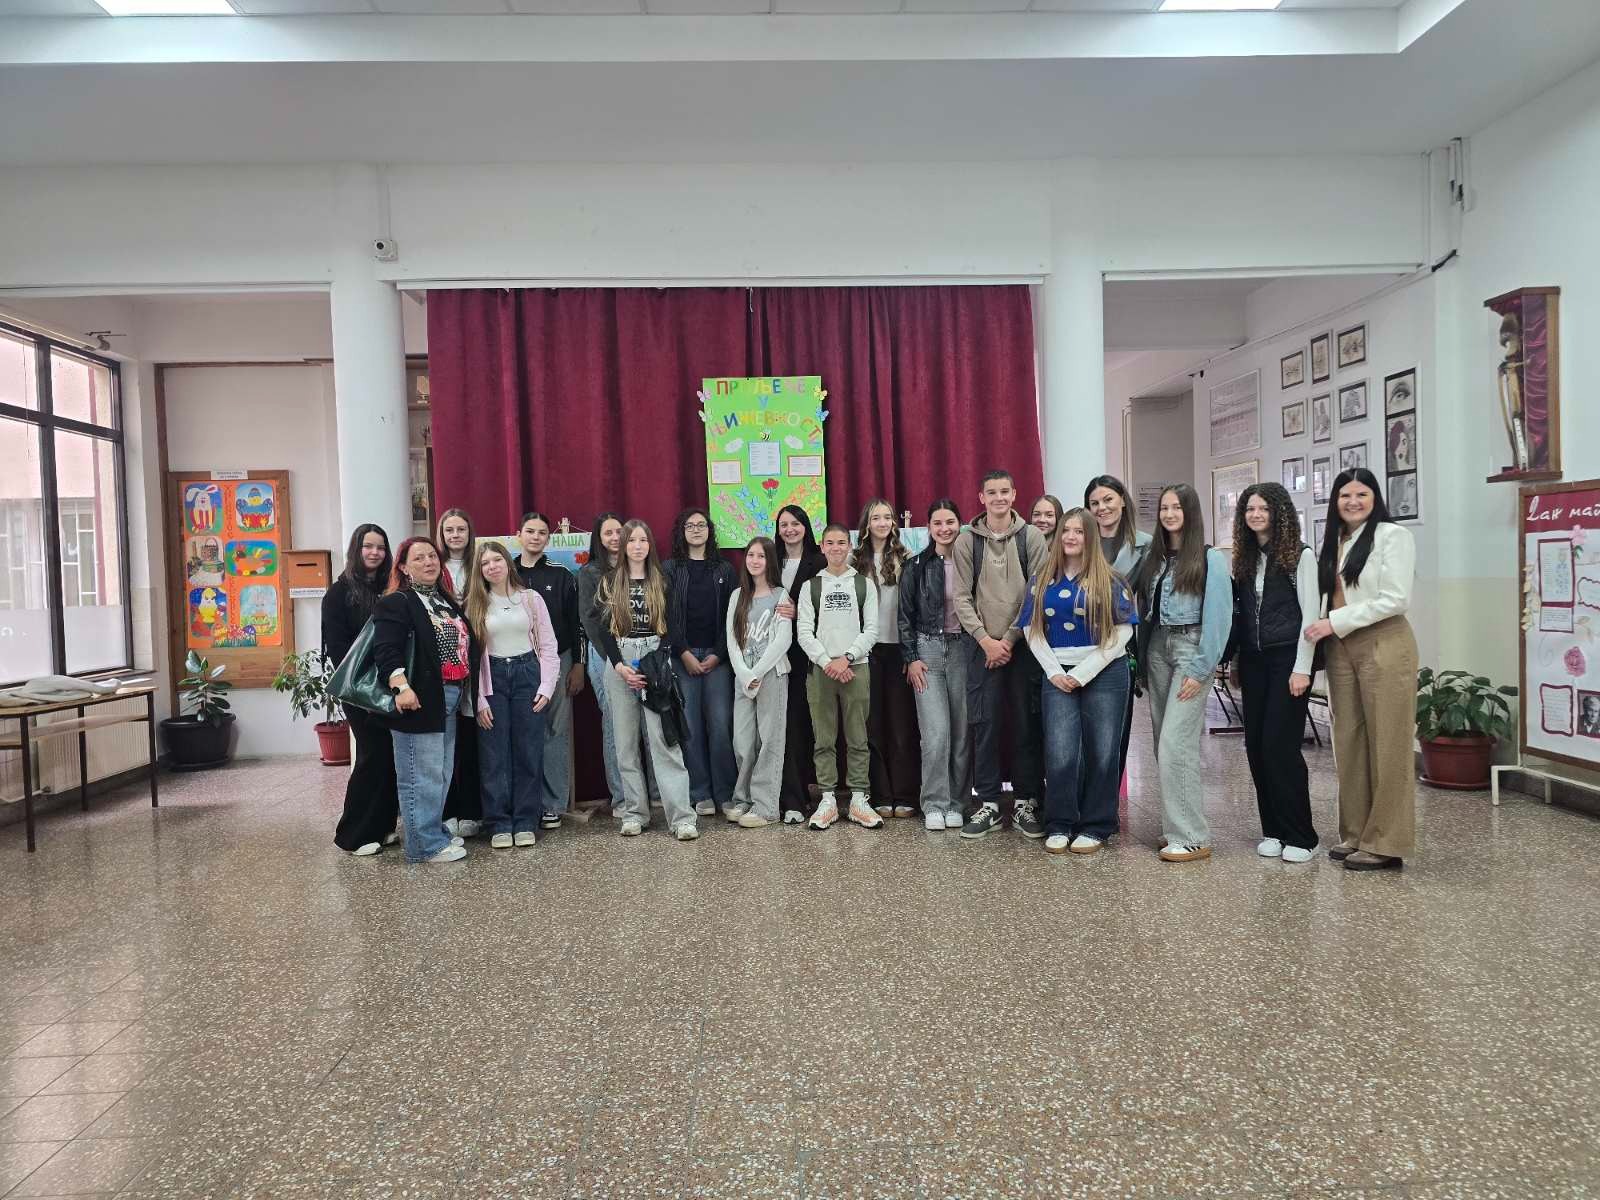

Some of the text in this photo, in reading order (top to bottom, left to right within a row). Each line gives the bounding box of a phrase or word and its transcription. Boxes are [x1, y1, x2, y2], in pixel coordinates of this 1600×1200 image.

[716, 379, 806, 396] ПРЉЕЕ
[707, 410, 821, 452] ЊИЖЕВНОСТИ
[552, 535, 585, 547] НАША
[632, 614, 650, 623] END
